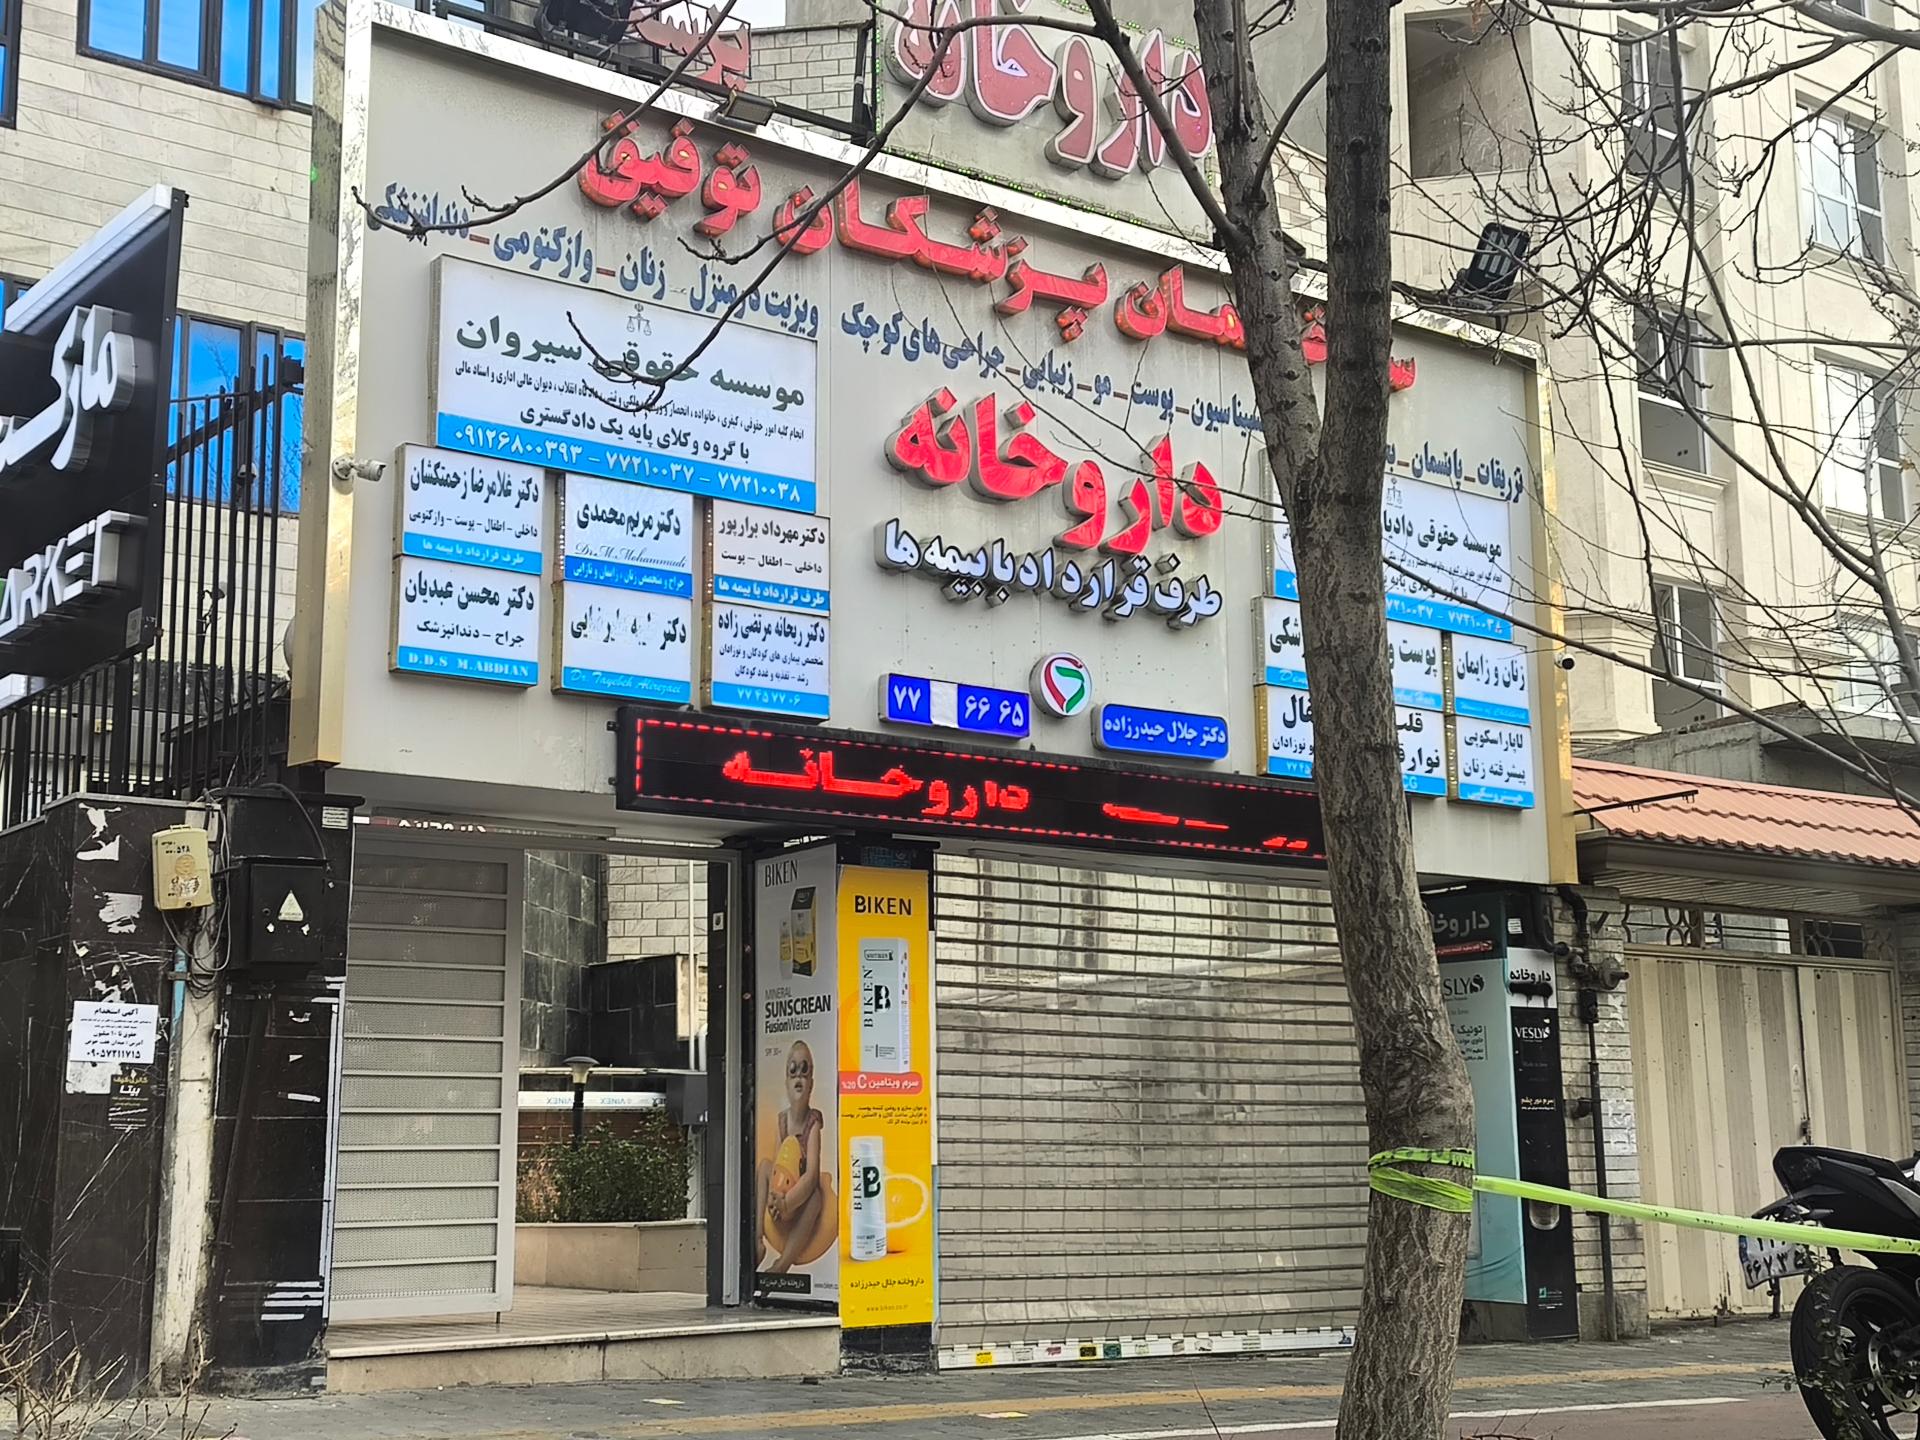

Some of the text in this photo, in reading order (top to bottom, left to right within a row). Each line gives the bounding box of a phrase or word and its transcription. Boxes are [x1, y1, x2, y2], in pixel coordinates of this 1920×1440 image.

[577, 109, 1108, 343] پزشکان توفیق
[494, 226, 593, 283] وازکتومی
[619, 246, 665, 300] زنان
[689, 264, 738, 313] منزل
[765, 291, 818, 338] ویزیت
[841, 302, 903, 355] کوچک
[456, 315, 804, 411] موسسه حقوقی سیروان
[1023, 349, 1074, 399] زیبایی
[1094, 375, 1111, 405] مو
[1131, 382, 1174, 424] پوست
[520, 406, 595, 430] دادگستری
[600, 418, 622, 436] یک
[455, 424, 582, 464] ۰۹۱۲۶۸۰۰۳۹۳
[629, 423, 652, 448] پایه
[704, 440, 735, 460] گروه
[741, 442, 749, 463] با
[1412, 441, 1462, 490] پانسمان
[471, 467, 512, 503] غلامرضا
[885, 386, 1224, 554] داروخانه
[1478, 458, 1523, 503] تزریقات
[515, 478, 538, 508] دکتر
[577, 504, 680, 540] دکتر مریم محمدی
[762, 521, 798, 543] مهرداد
[800, 528, 825, 546] دکتر
[875, 518, 921, 570] ها
[1418, 519, 1501, 563] موسسه حقوقی
[0, 510, 129, 638] ARKET
[721, 551, 822, 573] داخلی اطفال پوست
[922, 535, 989, 596] بیمه
[405, 570, 534, 616] دکتر محسن عبدیان
[719, 578, 824, 607] طرف قرارداد با بیمه ها
[1152, 553, 1223, 629] طرف
[719, 610, 738, 637] زاده
[1386, 598, 1433, 619] ۷۲۱۰۰۳۷
[417, 620, 524, 647] جراح دندانپزشک
[660, 617, 686, 650] دکتر
[805, 622, 824, 648] دکتر
[409, 653, 448, 668] D.D.S
[1399, 640, 1437, 678] پوست
[1457, 651, 1525, 691] زنان و زایمان
[893, 685, 1024, 728] ۷۷ ۶۶ ۶۵
[1283, 694, 1312, 728] فال
[1104, 715, 1226, 746] دکتر جلال حیدرزاده
[1273, 736, 1305, 754] نوزادان
[1407, 747, 1440, 774] نوار
[1463, 758, 1486, 779] زنان
[722, 748, 1030, 819] داروخانه
[1404, 775, 1417, 789] CG
[765, 860, 797, 887] BIKEN
[854, 895, 911, 915] BIKEN
[1431, 911, 1490, 937] داروخا
[1510, 968, 1551, 984] داروخانه
[765, 995, 831, 1018] SUNSCREAN
[864, 966, 873, 1027] BIKEN
[857, 1074, 919, 1089] سرم ویتامین C
